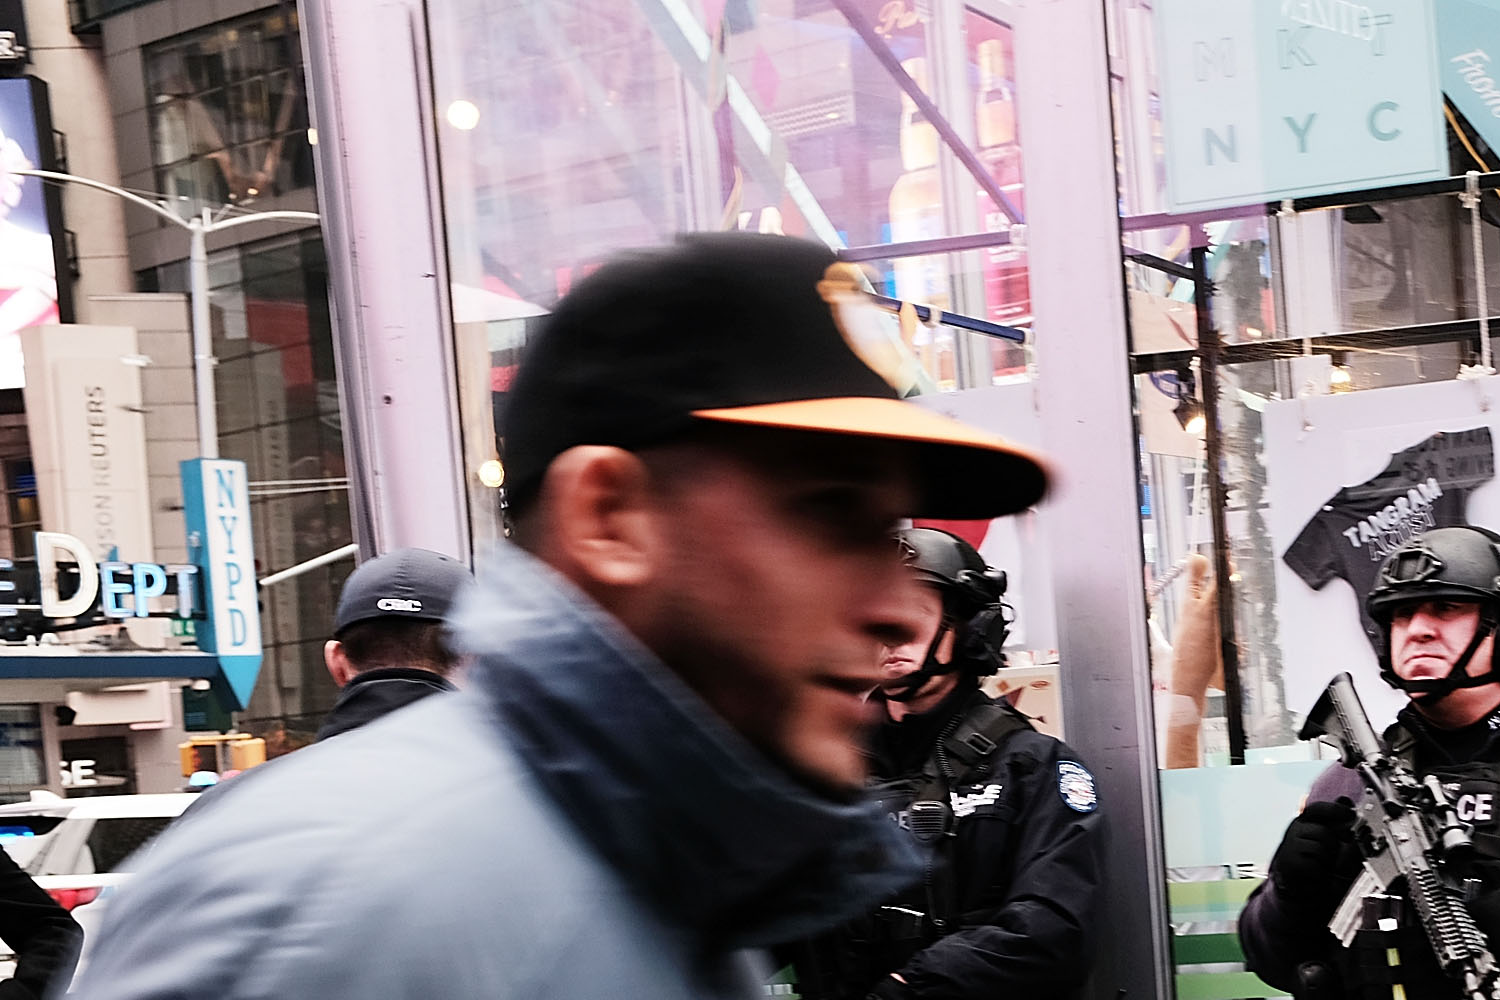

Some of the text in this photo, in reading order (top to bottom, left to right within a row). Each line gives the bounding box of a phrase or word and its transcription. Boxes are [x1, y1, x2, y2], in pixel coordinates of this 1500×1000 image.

[85, 385, 112, 487] REUTERS
[211, 467, 248, 648] NYPD
[1342, 477, 1444, 548] TANGRAM
